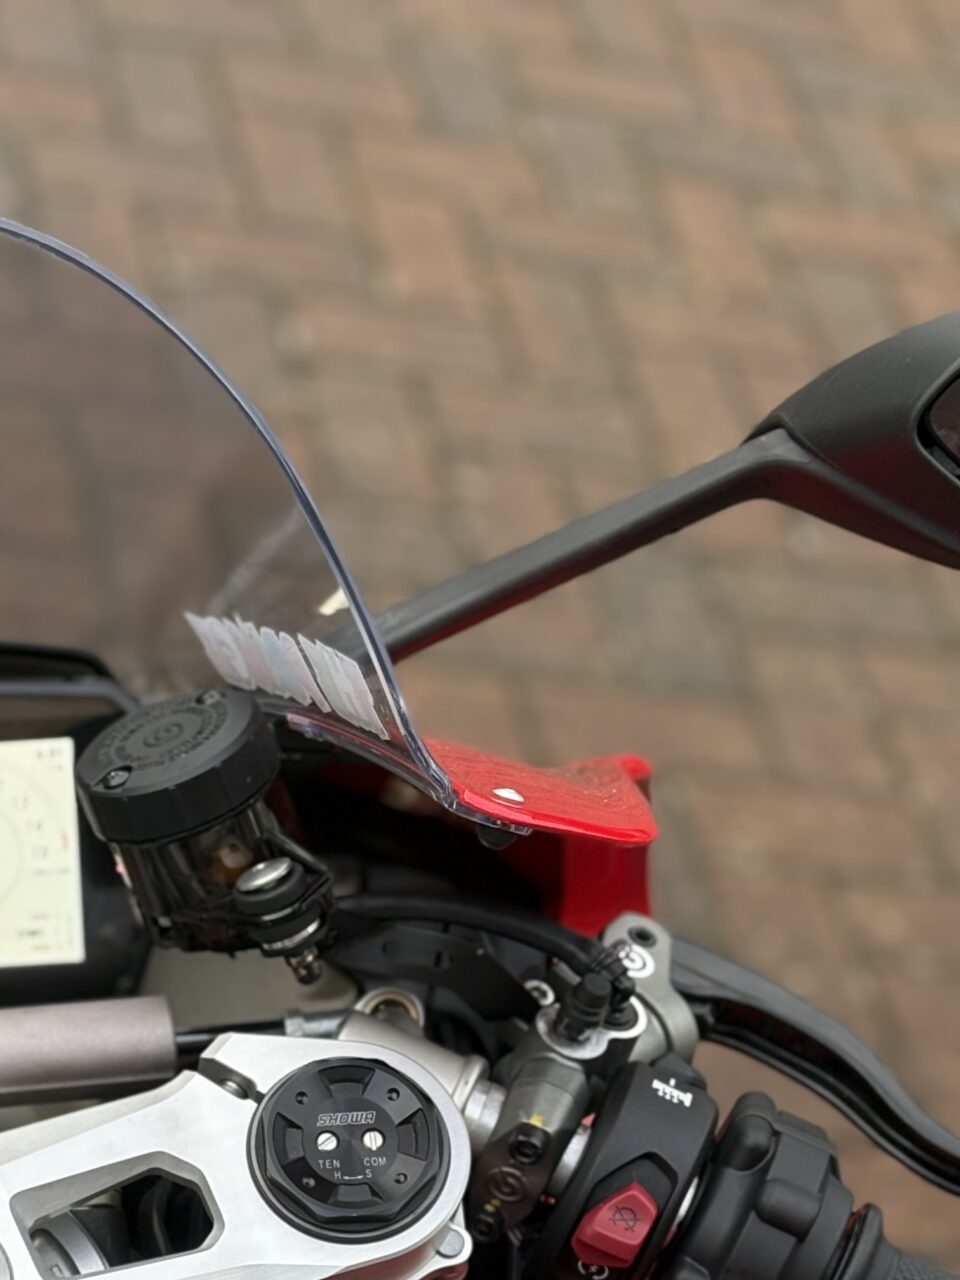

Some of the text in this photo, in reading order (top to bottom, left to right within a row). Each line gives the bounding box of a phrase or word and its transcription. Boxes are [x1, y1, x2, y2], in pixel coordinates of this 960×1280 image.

[317, 1111, 376, 1126] SHOWA
[318, 1157, 387, 1169] TEN COM
[334, 1169, 373, 1180] H S
